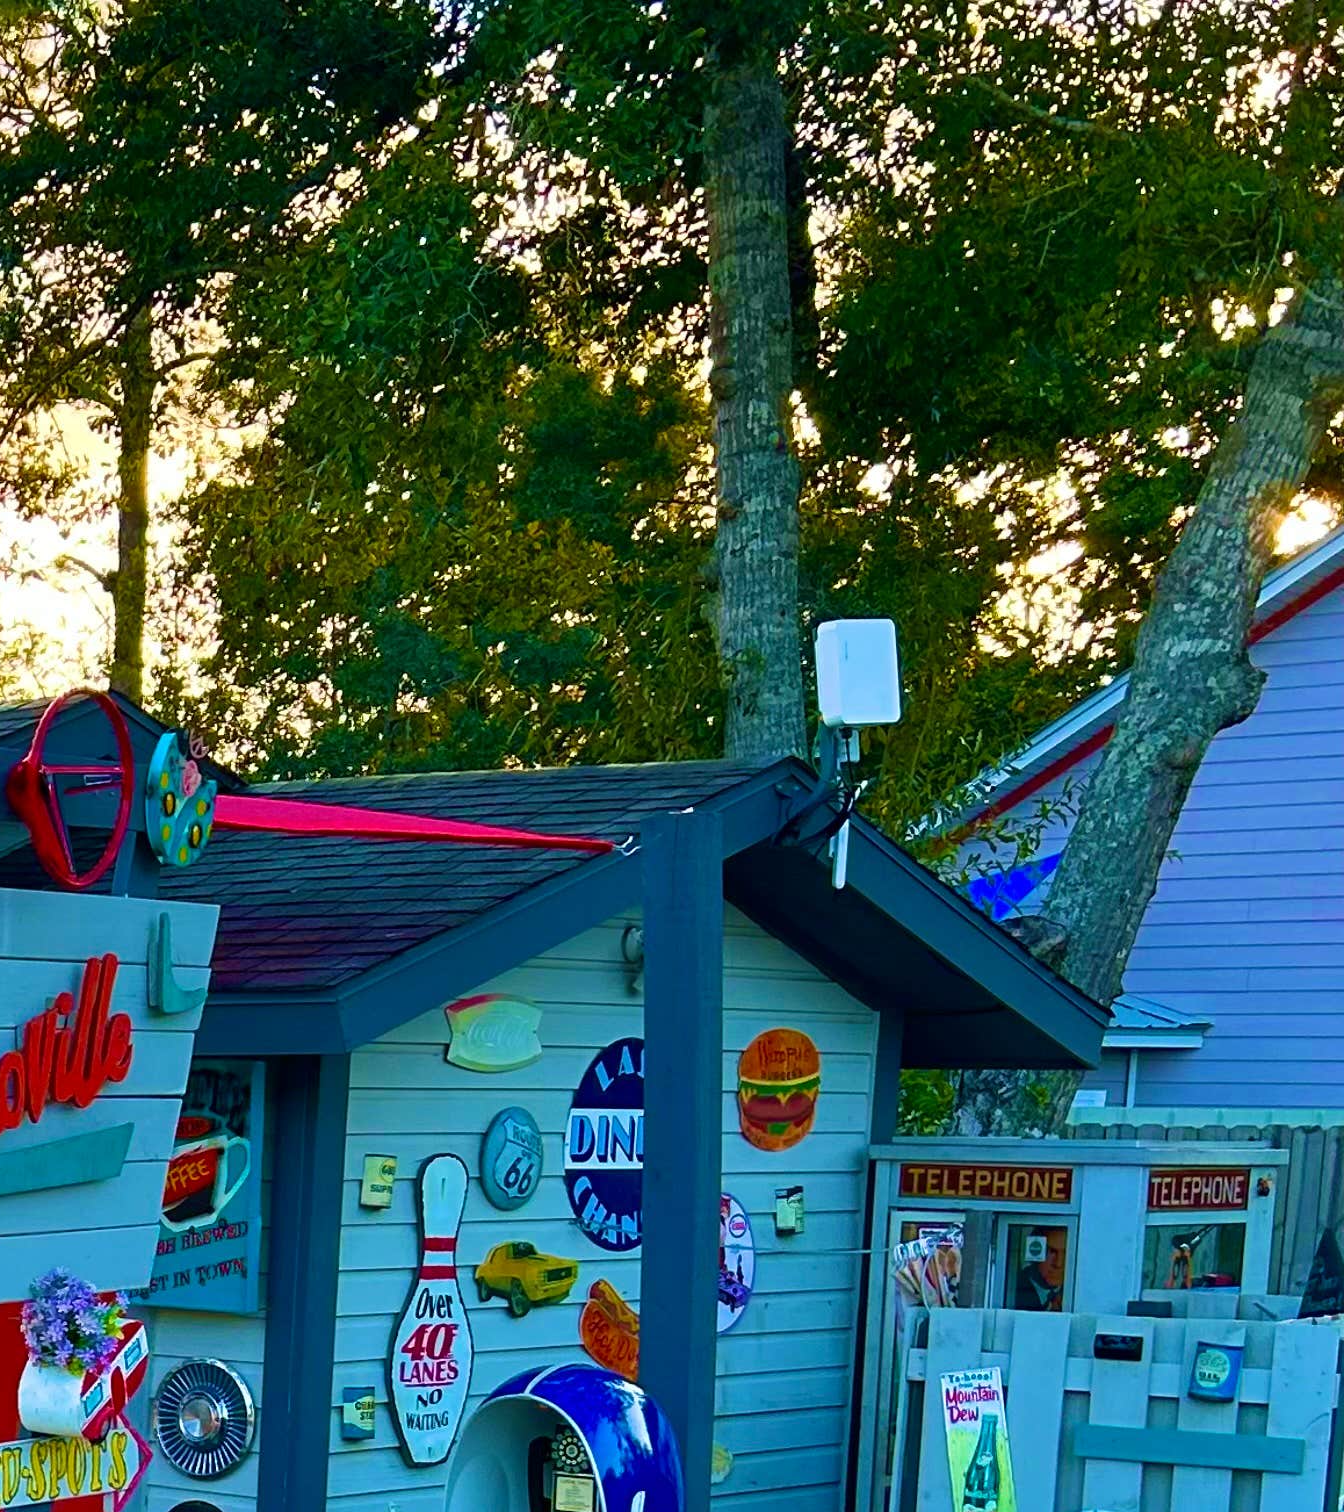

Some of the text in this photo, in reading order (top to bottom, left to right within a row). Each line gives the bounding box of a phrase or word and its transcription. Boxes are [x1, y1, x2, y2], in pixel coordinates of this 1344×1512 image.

[594, 1046, 644, 1091] LA
[503, 1157, 533, 1196] 66
[908, 1167, 1067, 1199] TELEPHONE
[1150, 1174, 1245, 1206] TELEPHONE
[415, 1287, 452, 1320] Over
[399, 1360, 459, 1384] LANES
[416, 1388, 443, 1411] NO
[945, 1383, 1000, 1407] Mountain
[405, 1411, 449, 1431] WAITING
[947, 1405, 979, 1424] Dew
